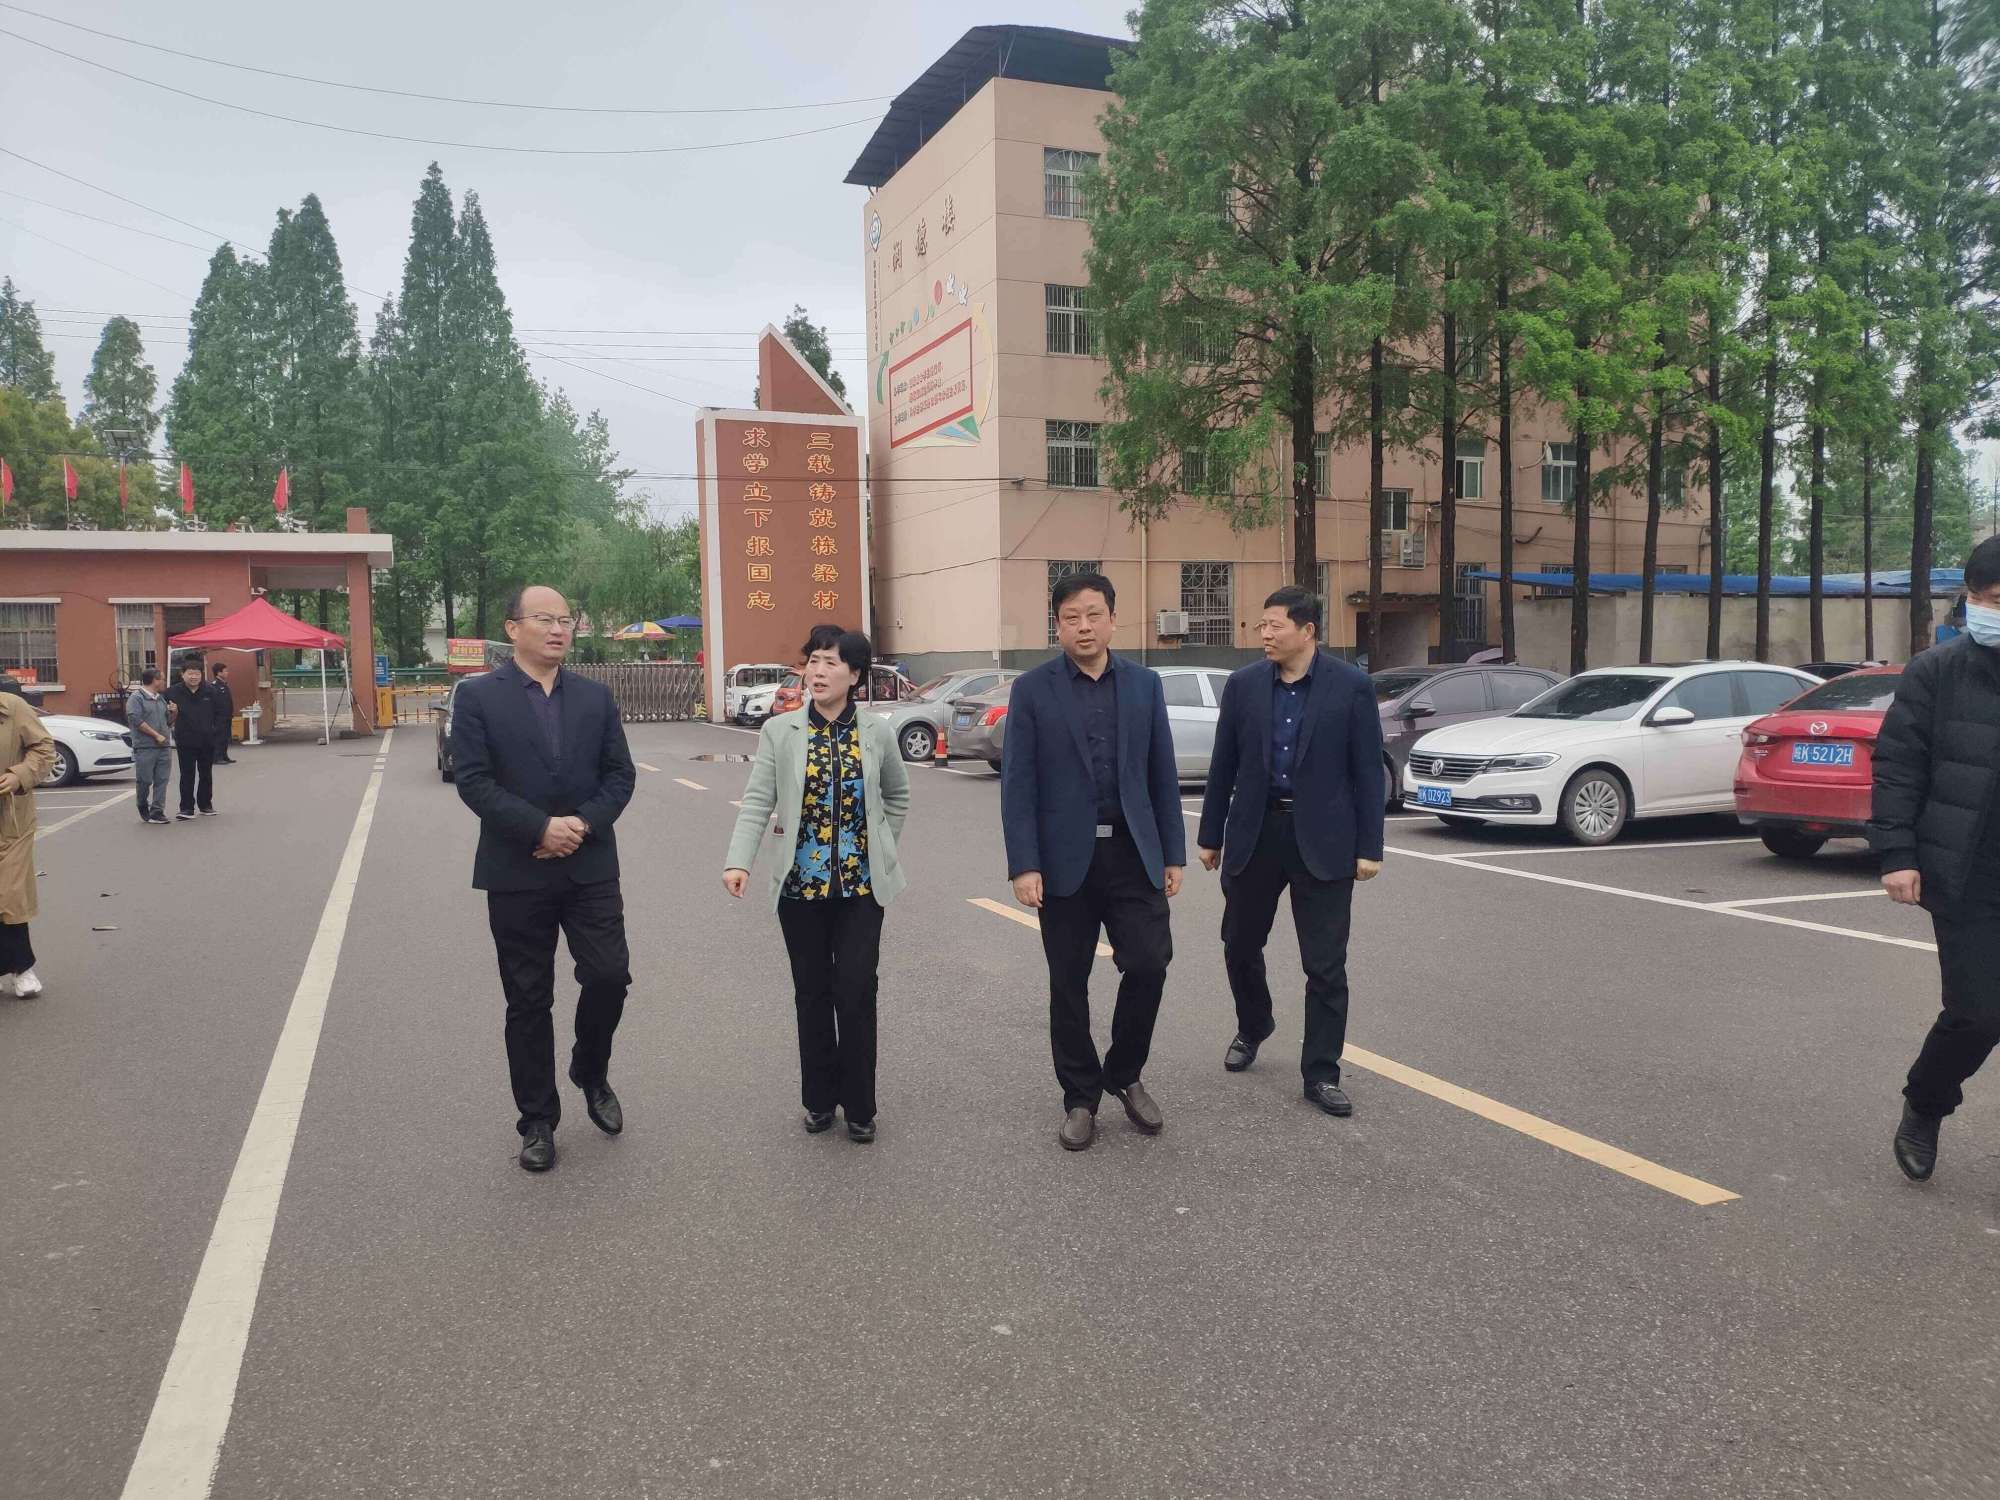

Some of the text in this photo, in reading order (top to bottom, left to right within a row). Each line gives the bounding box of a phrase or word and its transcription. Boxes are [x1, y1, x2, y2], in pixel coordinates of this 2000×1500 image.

[742, 427, 775, 611] 求学立下报国志
[806, 432, 839, 610] 三载铸就栋梁材
